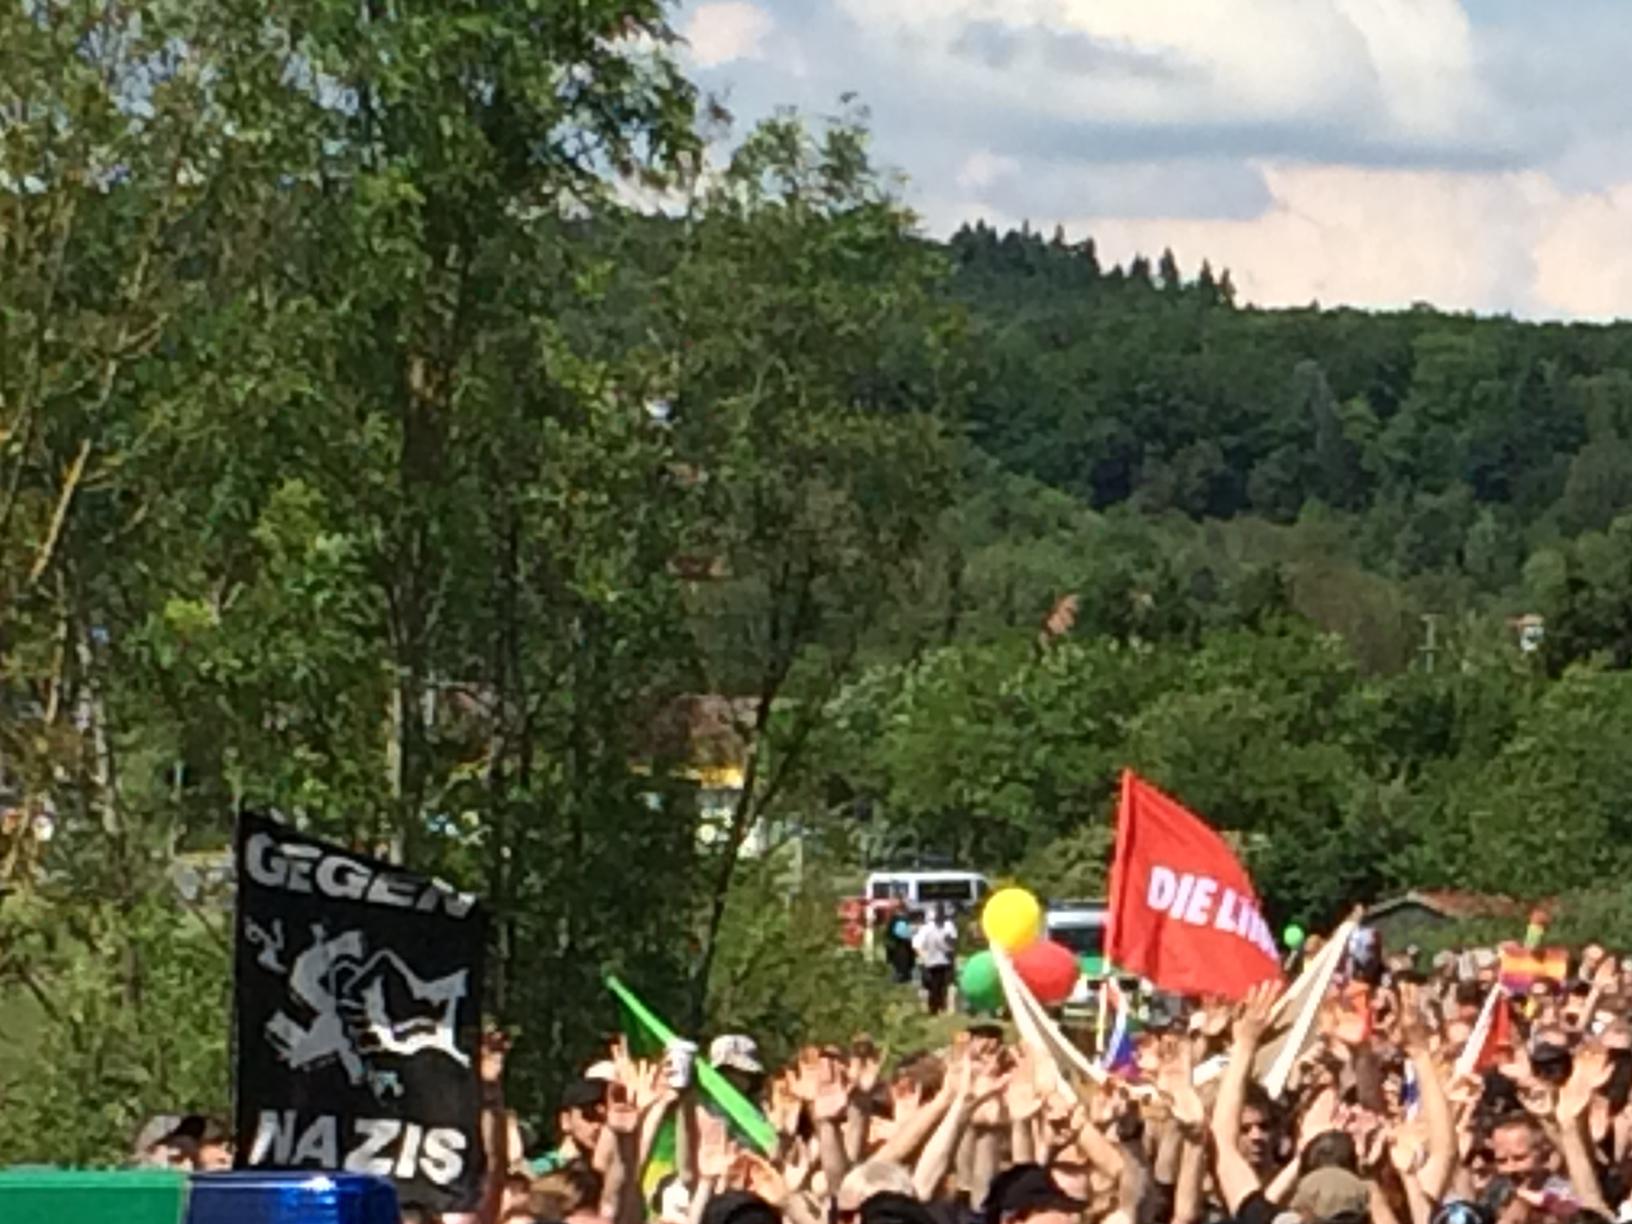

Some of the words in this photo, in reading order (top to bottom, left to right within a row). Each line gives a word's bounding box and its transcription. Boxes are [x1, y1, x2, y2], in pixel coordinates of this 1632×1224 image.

[245, 832, 477, 918] GEGEN
[1147, 865, 1217, 926] DIE
[249, 1109, 467, 1185] NAZIS
